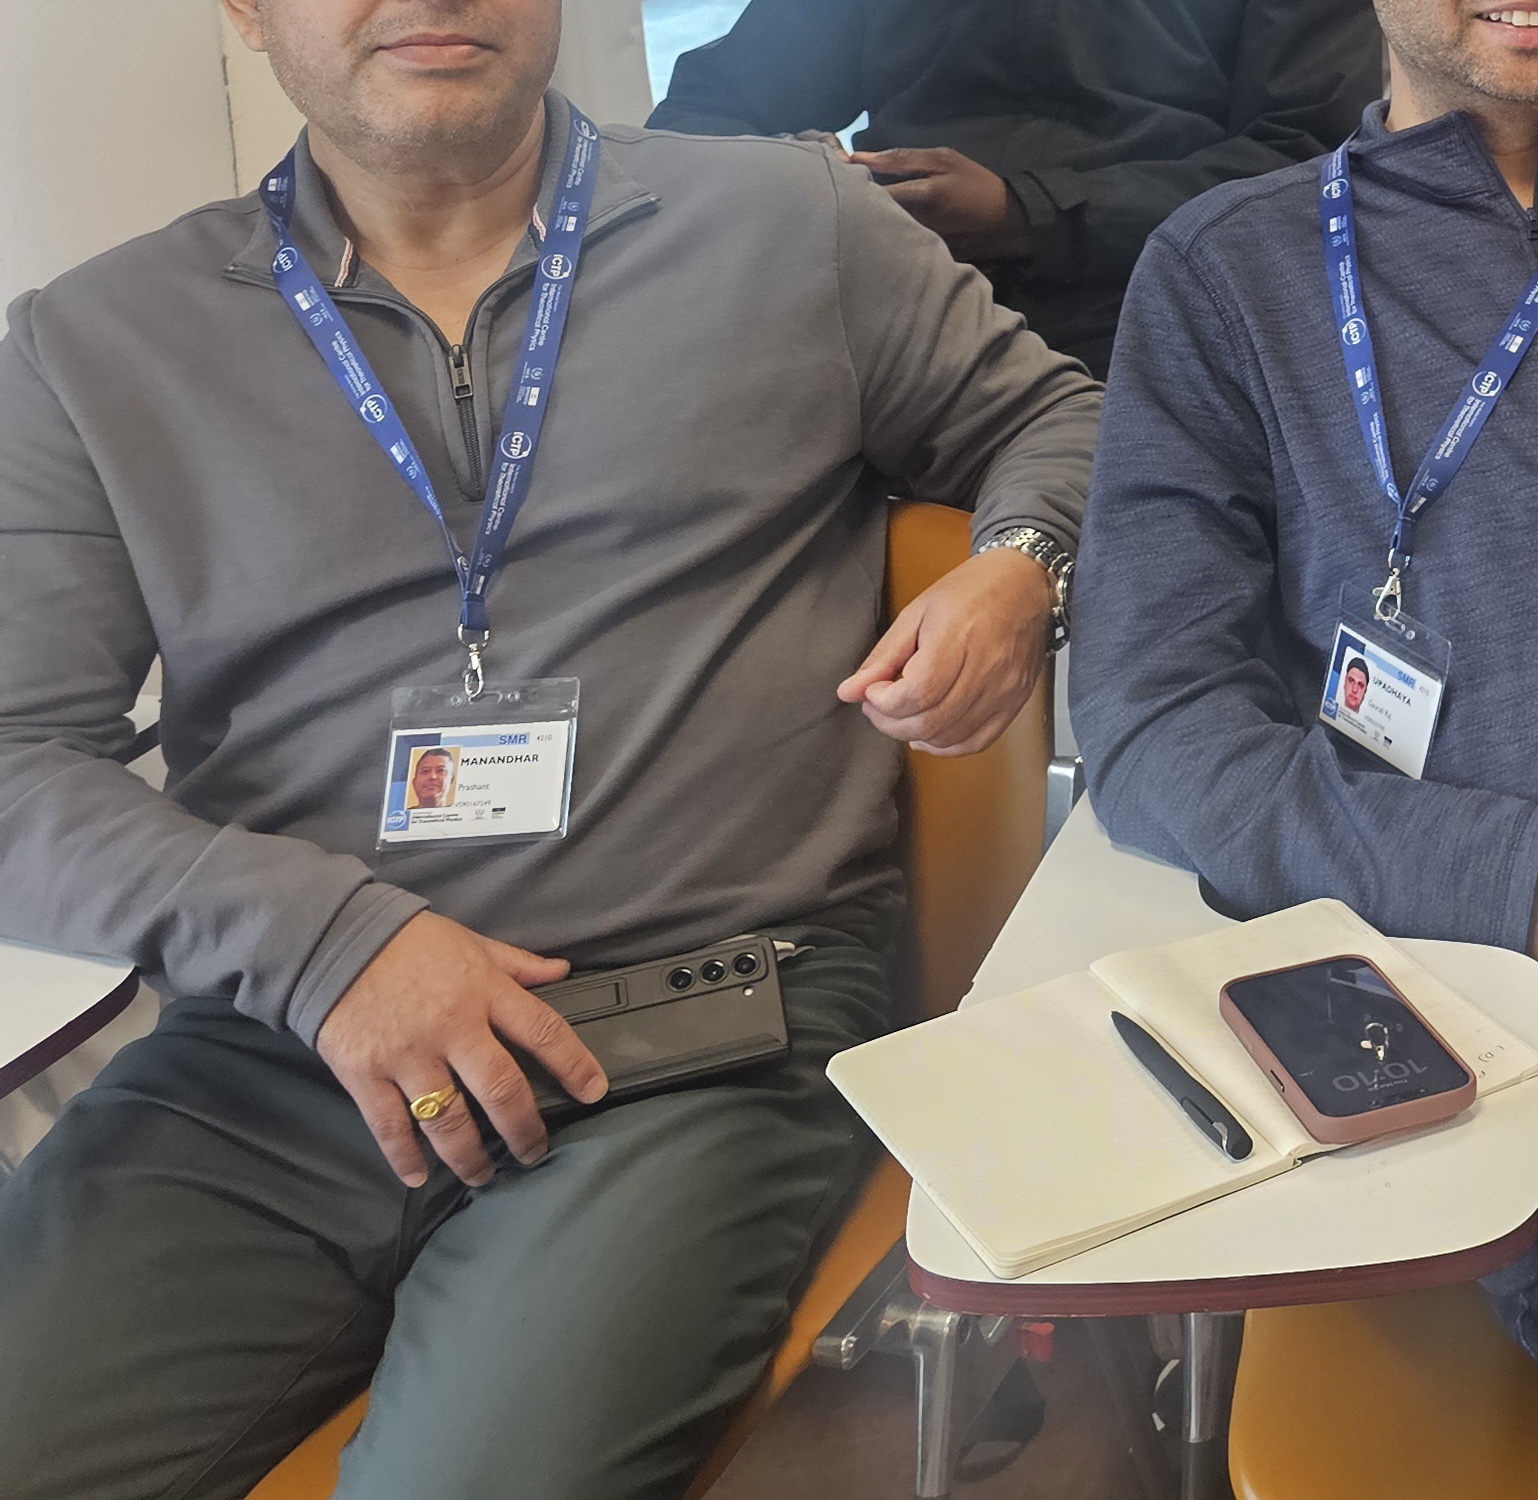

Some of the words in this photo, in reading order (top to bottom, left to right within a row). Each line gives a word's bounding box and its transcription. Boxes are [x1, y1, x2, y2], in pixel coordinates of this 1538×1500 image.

[276, 250, 293, 272] ICTP
[548, 252, 564, 277] ICTP
[533, 291, 548, 328] Theoretical
[542, 282, 558, 323] International
[333, 329, 350, 353] Physics
[527, 327, 540, 352] Physics
[536, 323, 549, 346] Centre
[1347, 321, 1361, 344] ICTP
[330, 339, 346, 361] Centre
[341, 359, 366, 396] International
[344, 350, 367, 383] Theoretical
[1479, 371, 1497, 394] ICTP
[365, 398, 386, 422] ICTP
[1458, 397, 1482, 437] International
[508, 430, 524, 456] ICTP
[1434, 437, 1451, 461] Physics
[1443, 436, 1460, 459] Centre
[491, 472, 506, 509] Theoretical
[499, 462, 516, 506] International
[484, 509, 497, 535] Physics
[491, 506, 505, 531] Centre
[1373, 676, 1412, 707] UPADHAYA
[1396, 671, 1417, 690] SMR
[499, 733, 527, 745] SMR
[460, 753, 539, 766] MANANDHAR
[457, 782, 490, 792] Prashant
